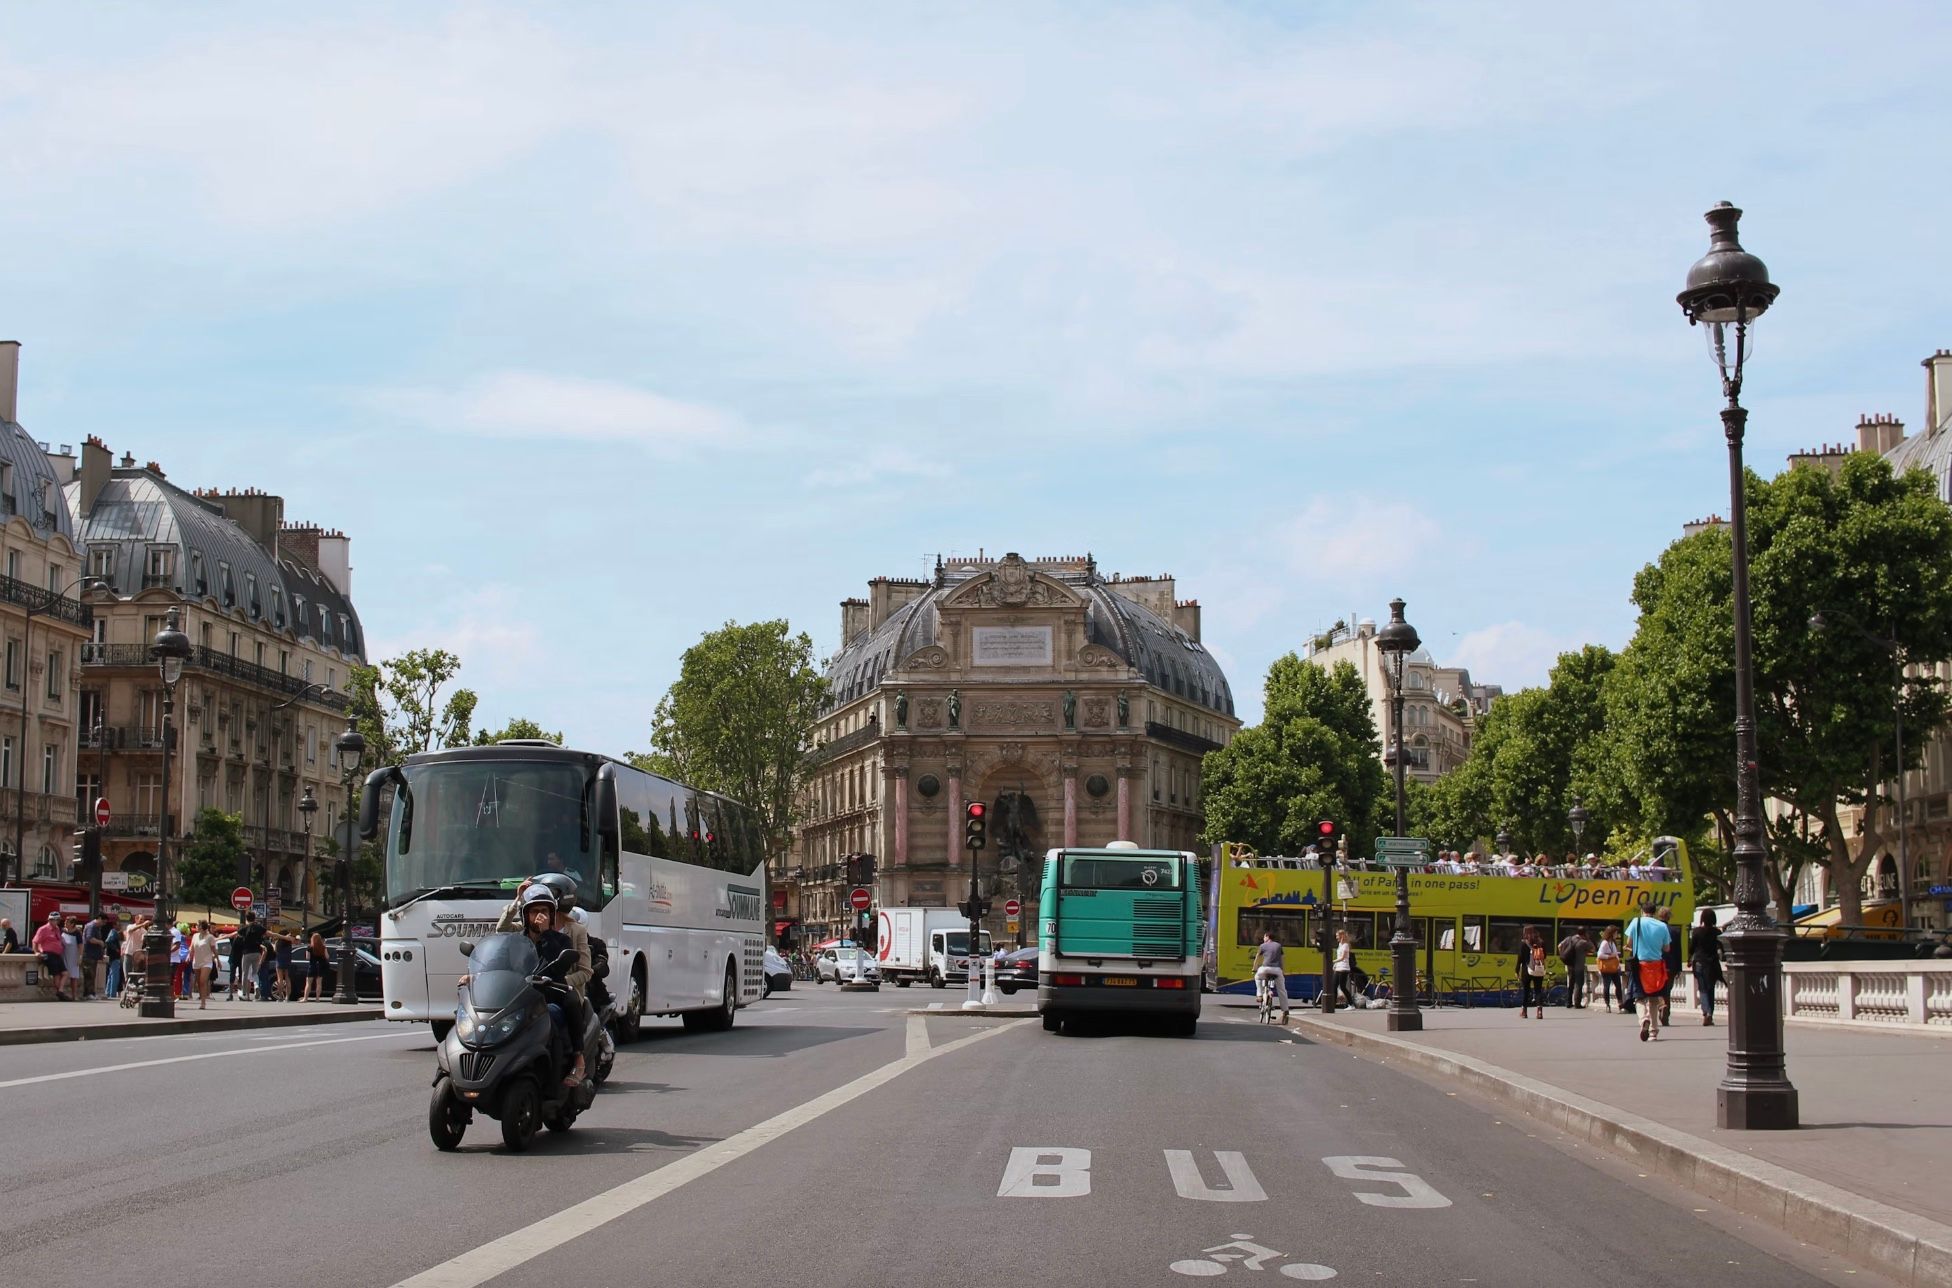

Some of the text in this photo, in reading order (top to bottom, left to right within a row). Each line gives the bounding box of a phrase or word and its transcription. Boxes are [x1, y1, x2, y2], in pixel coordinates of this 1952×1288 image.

[1363, 876, 1375, 887] of
[1411, 878, 1421, 889] in
[1424, 880, 1446, 889] one
[1448, 880, 1480, 891] pass!
[1047, 922, 1057, 934] 70
[997, 1146, 1453, 1209] BUS
